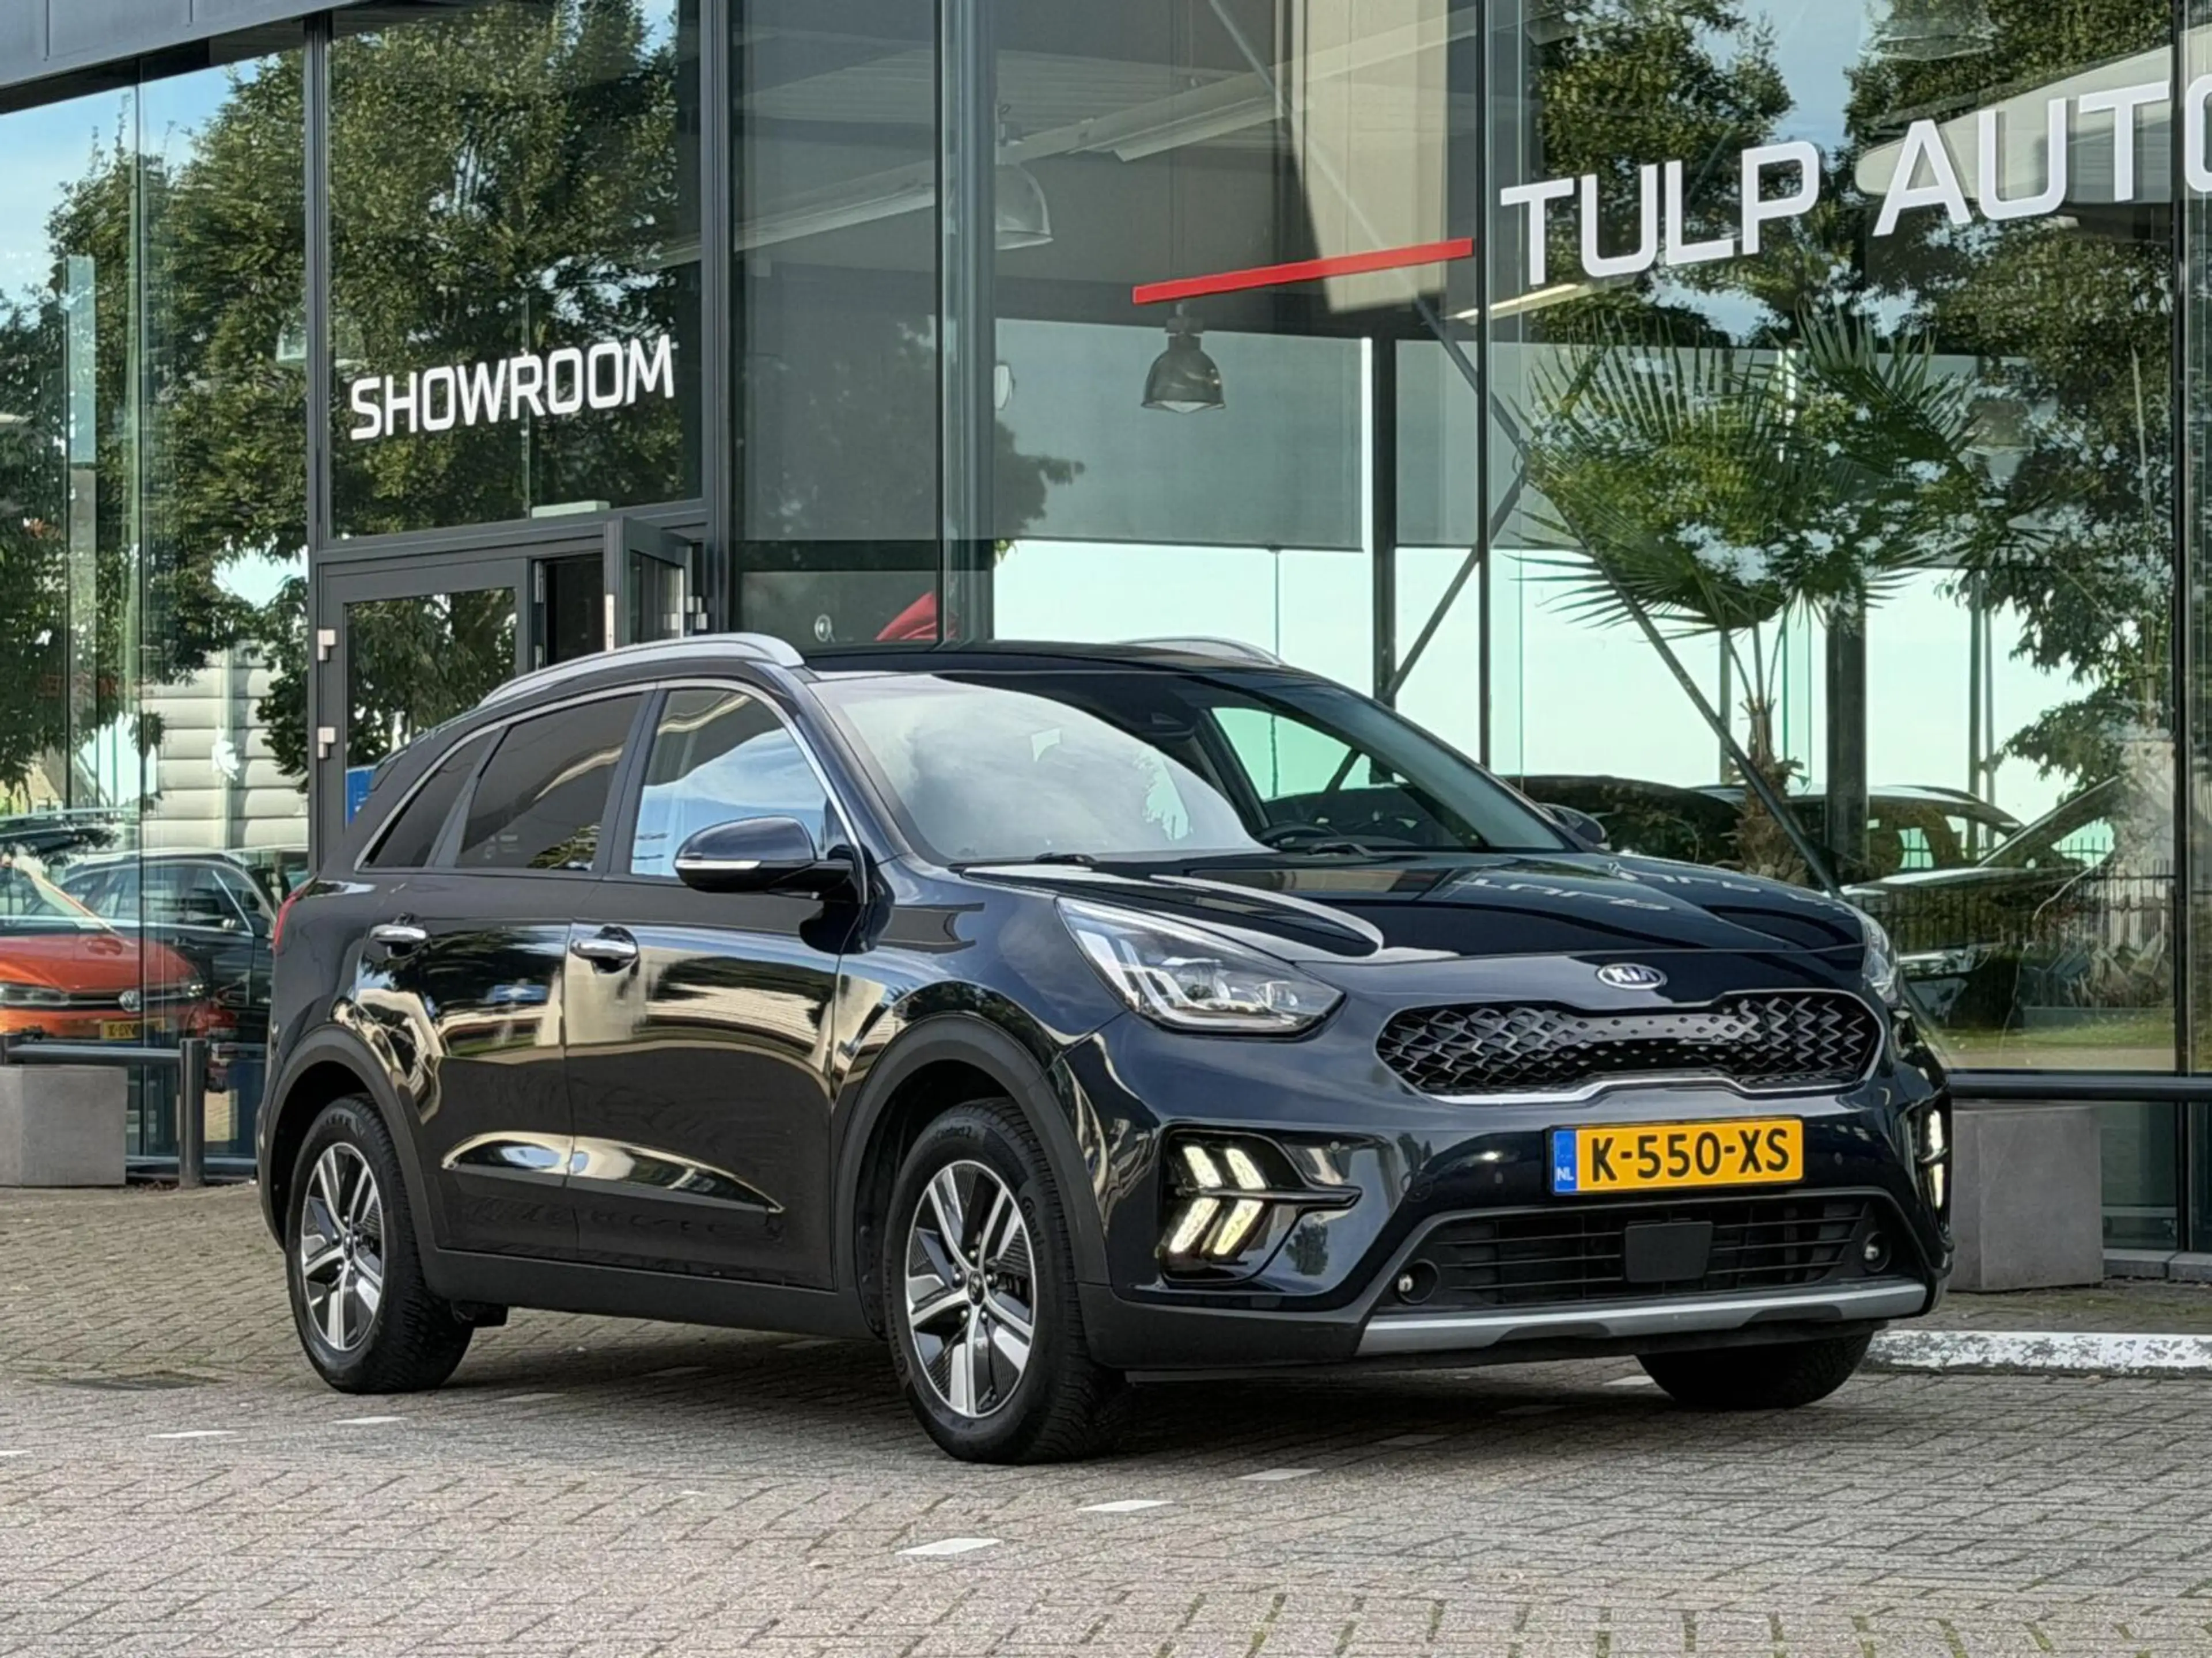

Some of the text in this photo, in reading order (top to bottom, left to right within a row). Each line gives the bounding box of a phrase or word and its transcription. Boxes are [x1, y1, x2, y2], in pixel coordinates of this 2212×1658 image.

[1499, 141, 1820, 286] TULP
[350, 334, 675, 441] SHOWROOM
[1604, 965, 1660, 984] KIA
[1556, 1166, 1574, 1182] NL
[1591, 1127, 1790, 1182] K-550-XS
